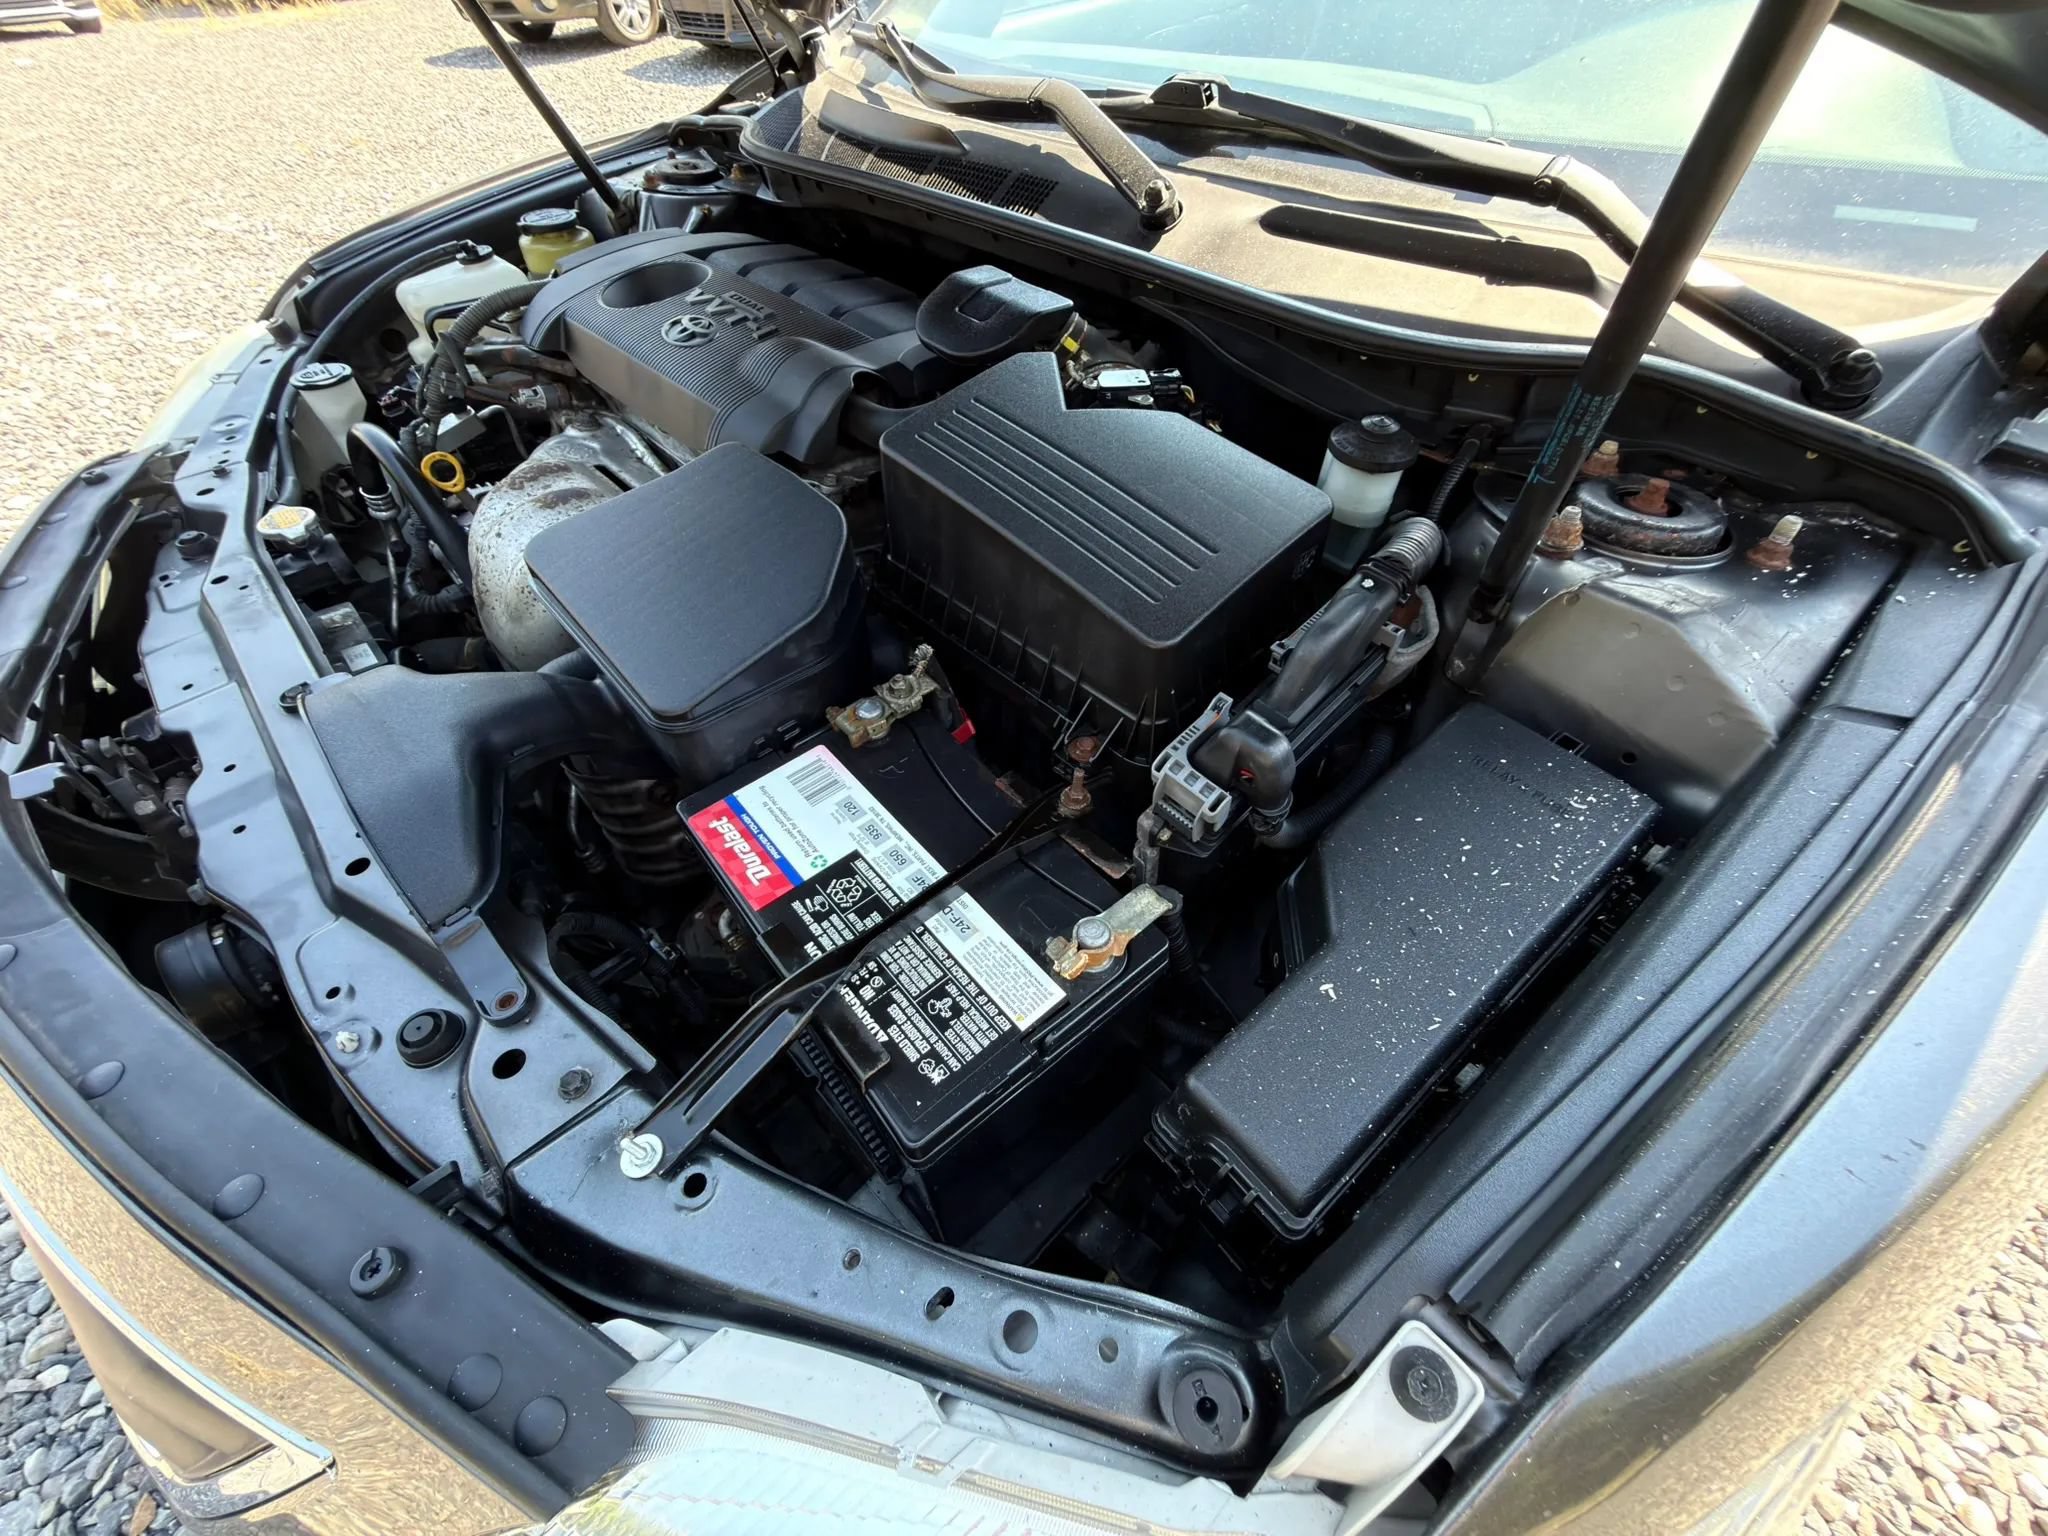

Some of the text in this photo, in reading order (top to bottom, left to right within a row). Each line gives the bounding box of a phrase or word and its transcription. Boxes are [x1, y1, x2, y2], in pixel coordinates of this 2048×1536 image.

[729, 293, 765, 313] DUAL
[841, 799, 861, 817] 120
[739, 812, 781, 860] PROVEN TOUGH
[863, 822, 884, 841] 935
[706, 814, 773, 887] Duralast
[887, 847, 908, 866] 650
[789, 898, 807, 916] CAUSE
[801, 912, 814, 925] CAN
[896, 942, 911, 956] NOT
[918, 930, 949, 960] CHILDREN.
[908, 956, 920, 967] OR
[921, 956, 944, 979] SERVICE
[941, 956, 955, 968] OF
[896, 955, 928, 990] INSTRUCTIONS
[914, 962, 936, 985] MANUAL
[948, 963, 972, 986] REACH
[857, 983, 876, 1001] NO
[963, 981, 981, 996] THE
[974, 992, 989, 1005] OF
[942, 979, 1000, 1041] GET MEDICAL HELP FAST.
[981, 1000, 1000, 1017] OUT
[885, 1002, 931, 1054] EXPLOSIVE GASES
[889, 986, 962, 1072] CAN CAUSE BLINDNESS OR INJURY
[956, 1010, 992, 1048] WITH WATER.
[992, 1012, 1013, 1031] KEEP
[886, 1023, 921, 1063] SHIELD EYES
[942, 1027, 975, 1061] FLUSH EYES
[948, 1017, 984, 1054] IMMEDIATELY
